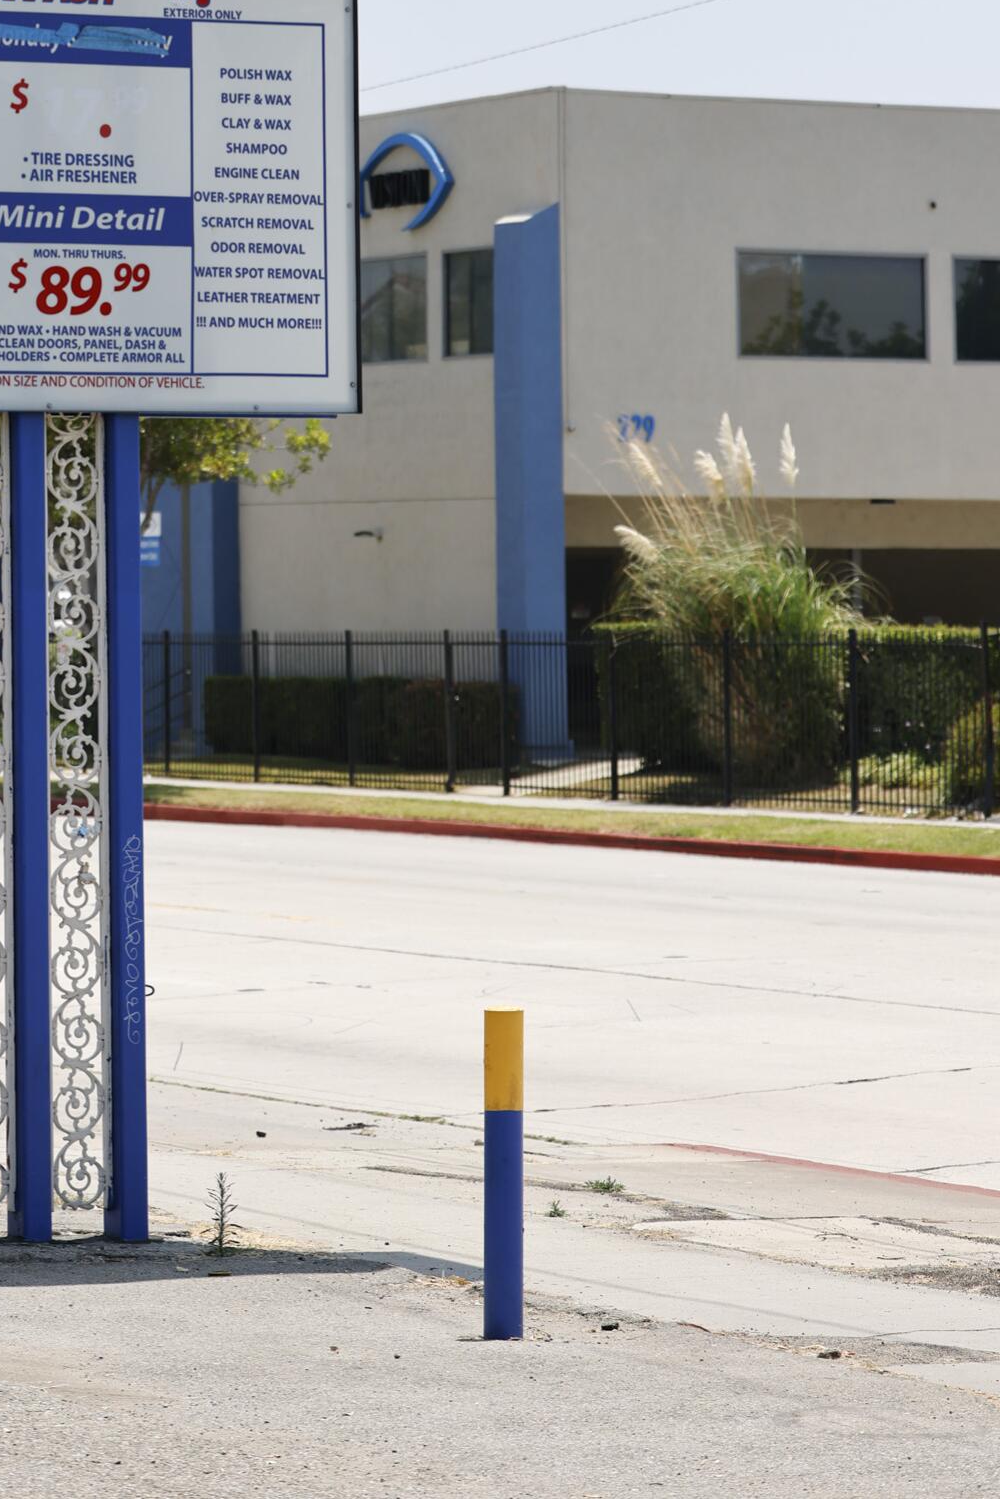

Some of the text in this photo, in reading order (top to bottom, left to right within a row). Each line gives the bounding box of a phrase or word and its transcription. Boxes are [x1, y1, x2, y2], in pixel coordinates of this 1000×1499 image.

[163, 8, 243, 21] EXTERIOR ONLY
[220, 67, 292, 81] POLISH WAX
[221, 92, 292, 106] BUFF & WAX
[221, 117, 292, 131] CLAY & WAX
[226, 142, 288, 155] SHAMPOO
[31, 152, 135, 168] TIRE DRESSING
[29, 169, 137, 184] AIR FRESHENER
[214, 166, 300, 180] ENGINE CLEAN
[193, 191, 324, 206] OVER-SPRAY REMOVAL
[71, 205, 166, 231] Detail
[201, 216, 315, 231] SCRATCH REMOVAL
[33, 249, 126, 260] MON. THRU THURS.
[210, 241, 306, 255] ODOR REMOVAL
[194, 266, 325, 280] WATER SPOT REMOVAL
[197, 291, 321, 305] LEATHER TREATMENT
[209, 316, 236, 328] AND
[238, 317, 274, 329] MUCH
[276, 318, 322, 330] MORE!!!
[17, 325, 43, 336] WAX
[52, 325, 86, 336] HAND
[88, 326, 121, 337] WASH
[124, 327, 132, 337] &
[134, 327, 182, 338] VACUUM
[37, 338, 81, 350] DOORS,
[83, 339, 122, 350] PANEL,
[125, 339, 155, 350] DASH
[158, 340, 167, 350] &
[0, 351, 50, 362] HOLDERS
[59, 351, 120, 363] COMPLETE
[122, 352, 163, 363] ARMOR
[165, 353, 185, 363] ALL
[14, 375, 37, 387] SIZE
[40, 375, 67, 388] AND
[70, 376, 136, 388] CONDITION
[138, 376, 155, 388] OF
[156, 376, 205, 389] VEHICLE.
